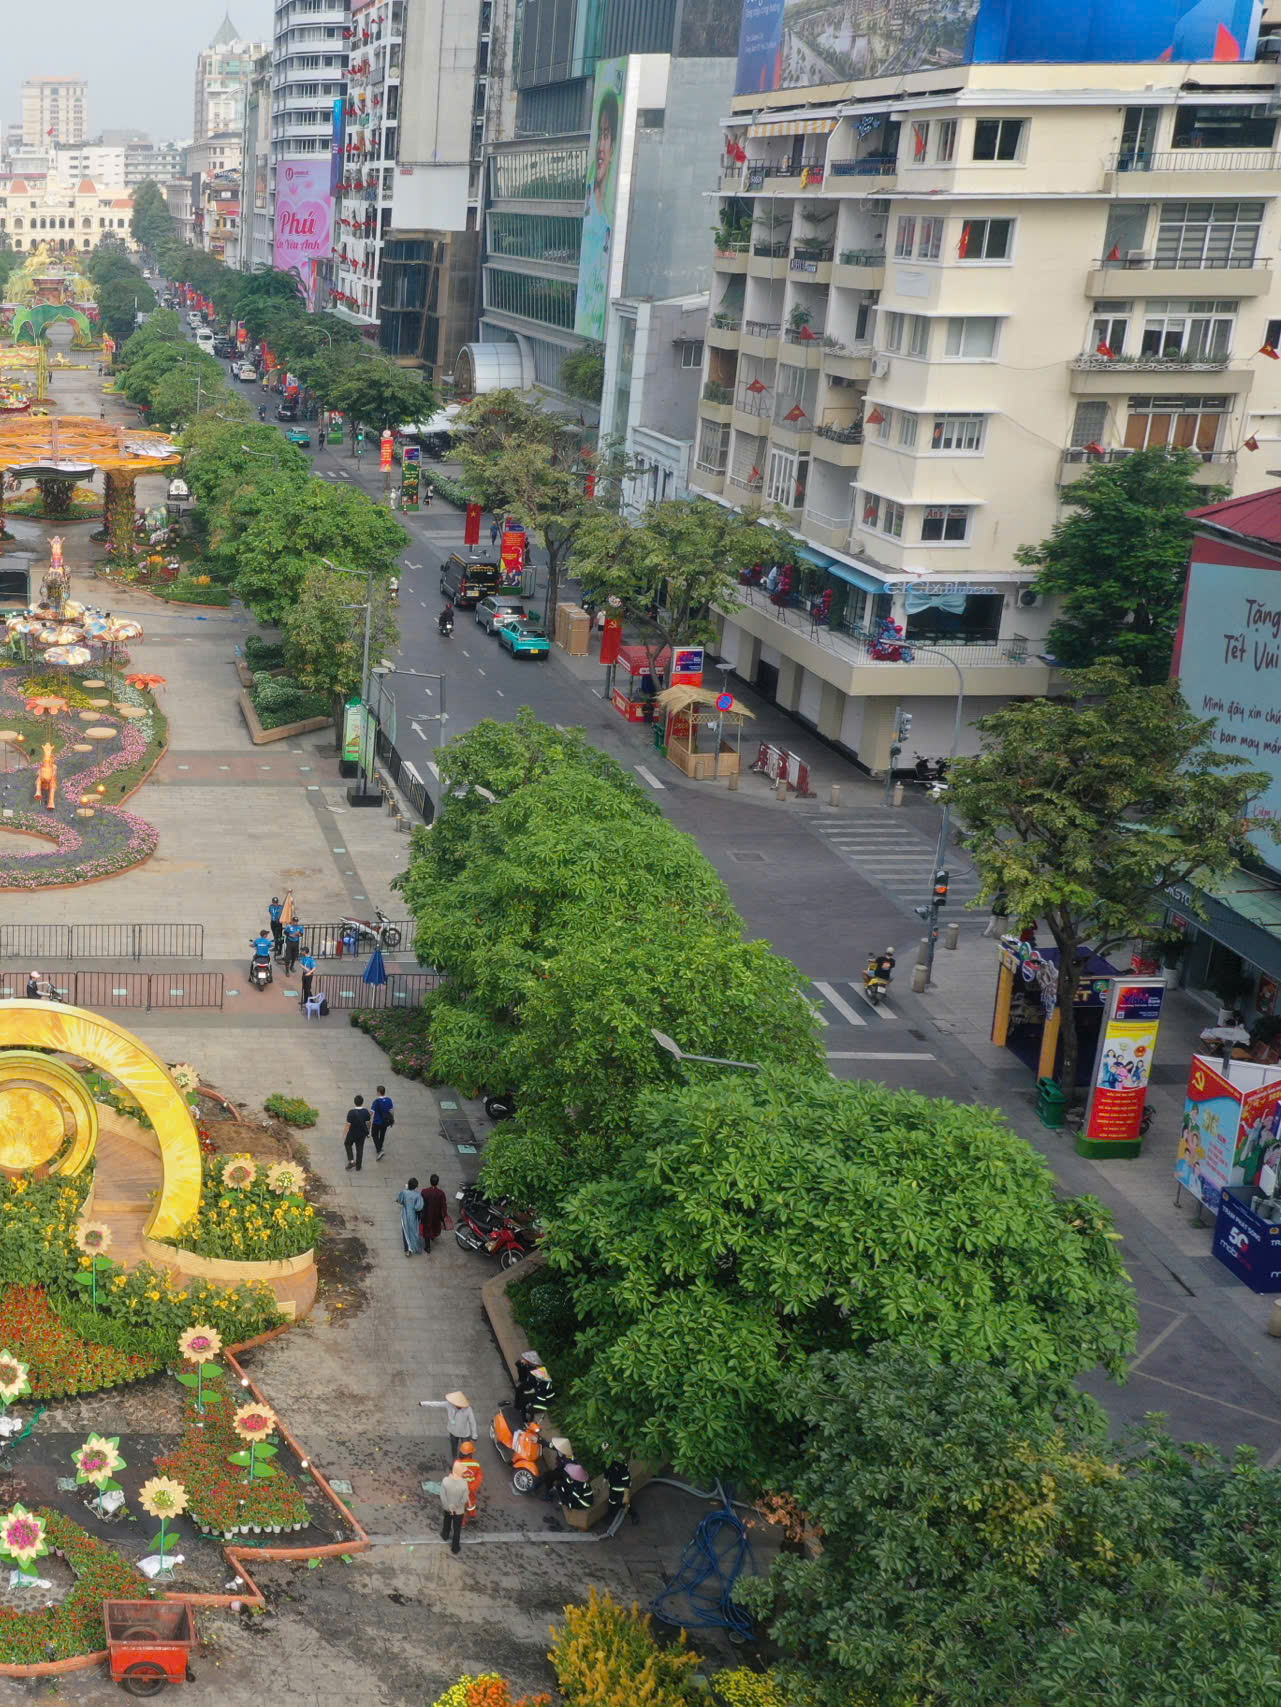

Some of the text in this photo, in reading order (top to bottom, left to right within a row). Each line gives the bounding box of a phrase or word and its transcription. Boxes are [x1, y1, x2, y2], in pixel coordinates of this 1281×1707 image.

[280, 210, 315, 235] Phú
[1245, 598, 1281, 639] Tặng
[1223, 633, 1280, 672] Tết Vui
[1247, 705, 1262, 719] xin
[1240, 736, 1260, 756] may
